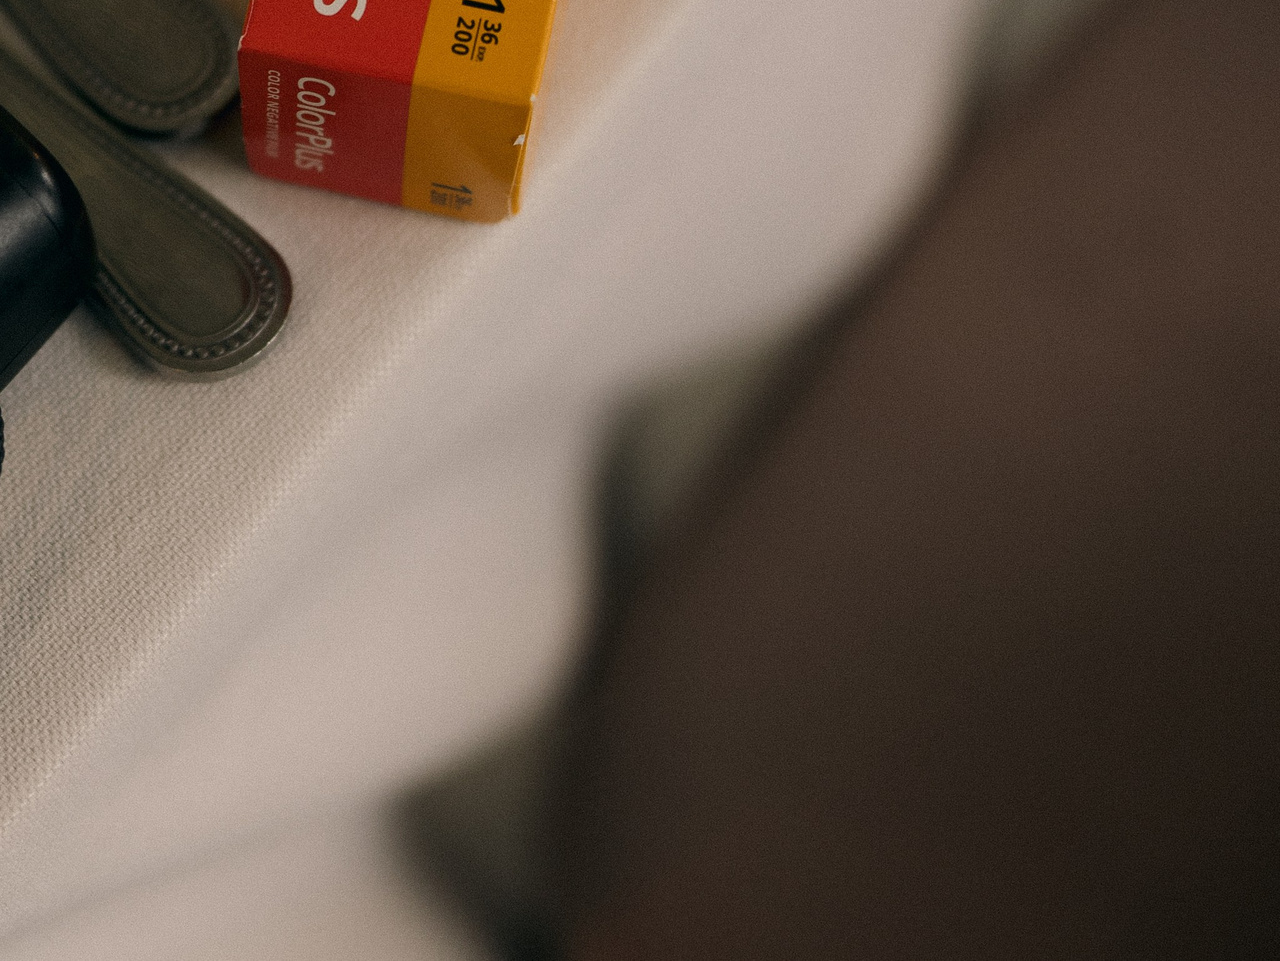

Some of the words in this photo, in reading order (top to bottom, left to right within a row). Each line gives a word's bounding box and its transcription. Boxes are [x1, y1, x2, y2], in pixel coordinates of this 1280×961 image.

[451, 16, 475, 56] 200
[481, 19, 502, 44] 36
[267, 69, 281, 99] COLOR
[294, 76, 337, 173] ColorPlus
